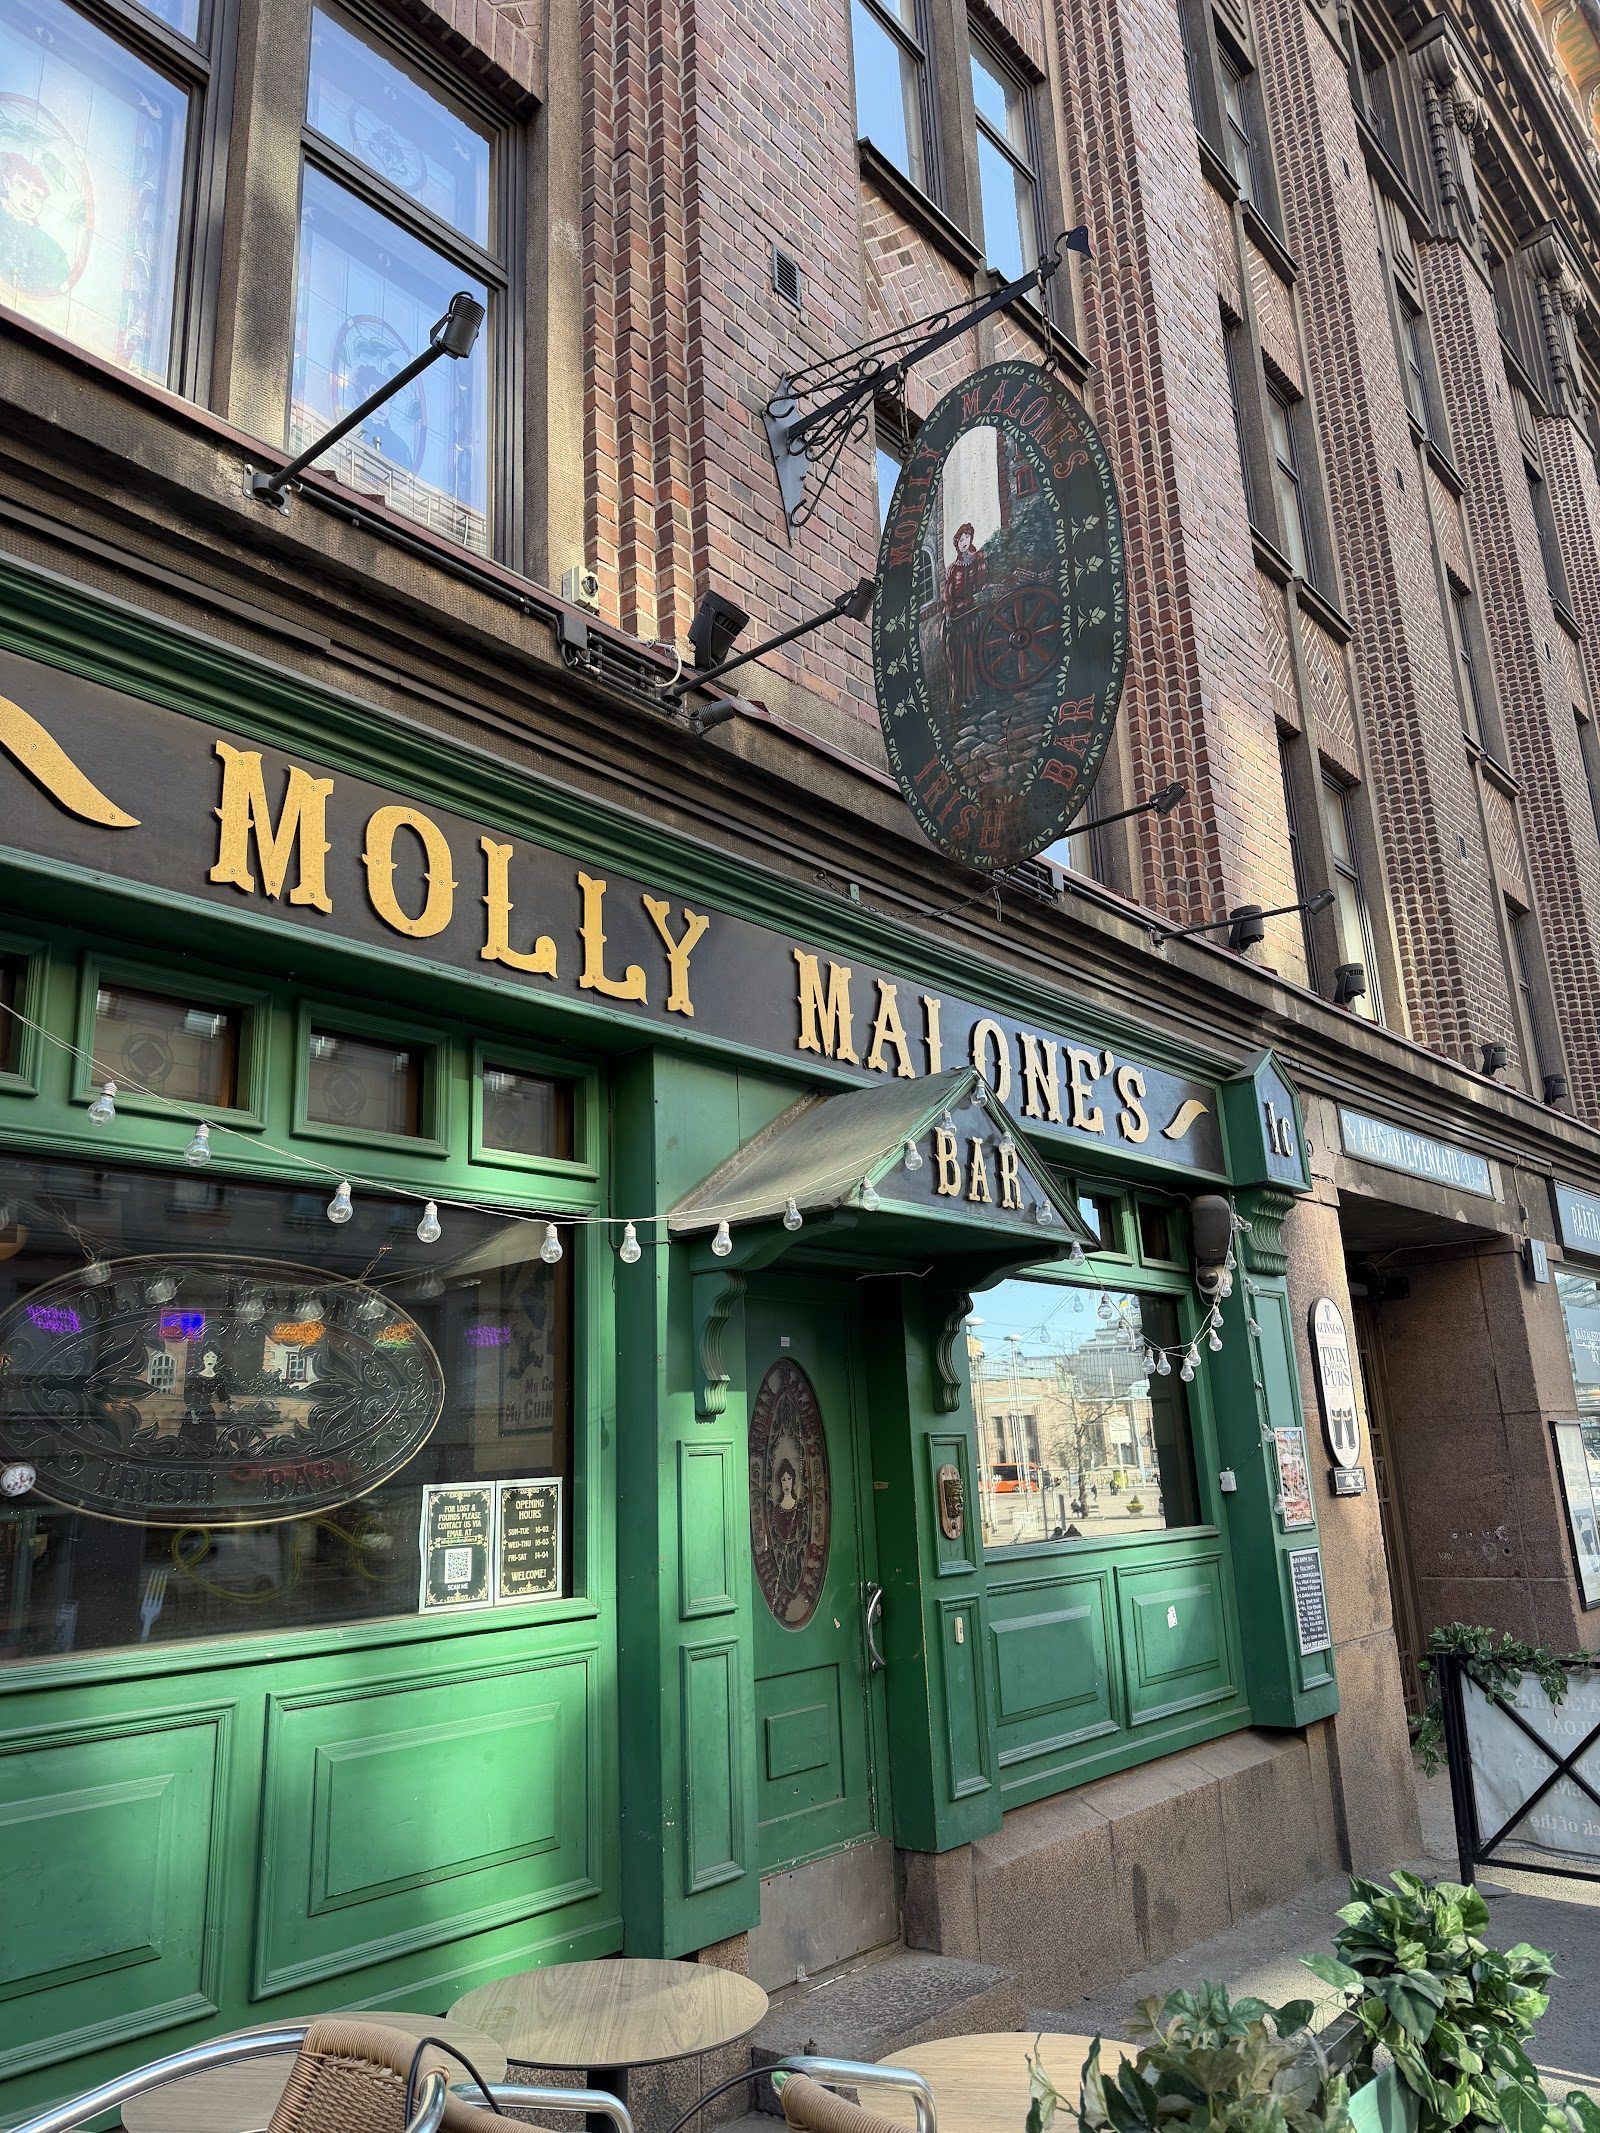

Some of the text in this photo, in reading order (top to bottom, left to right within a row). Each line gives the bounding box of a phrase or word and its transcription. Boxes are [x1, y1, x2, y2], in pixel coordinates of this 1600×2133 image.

[889, 379, 1089, 569] MOLLY MALONE'S
[913, 693, 1095, 849] IRISH BAR
[210, 739, 1150, 1143] MOLLY MALONE'S
[1358, 1119, 1459, 1182] KAISANIEMENKATU
[934, 1125, 1025, 1210] BAR
[1320, 1346, 1347, 1366] TWIN
[1322, 1365, 1350, 1387] PUBS
[94, 1458, 340, 1506] IRISH BAR
[444, 1505, 456, 1513] FOR
[457, 1504, 470, 1512] LOST
[515, 1498, 545, 1510] OPENING
[438, 1511, 482, 1521] FOUNDS PLEASE
[518, 1509, 542, 1520] HOURS
[437, 1521, 462, 1530] CONTACT
[472, 1520, 482, 1528] VIA
[507, 1526, 530, 1536] SUN-TUE
[446, 1530, 463, 1538] EMAIL
[507, 1539, 531, 1549] WED-THU
[507, 1552, 527, 1562] FRI-SAT
[511, 1568, 547, 1581] WELCOME!
